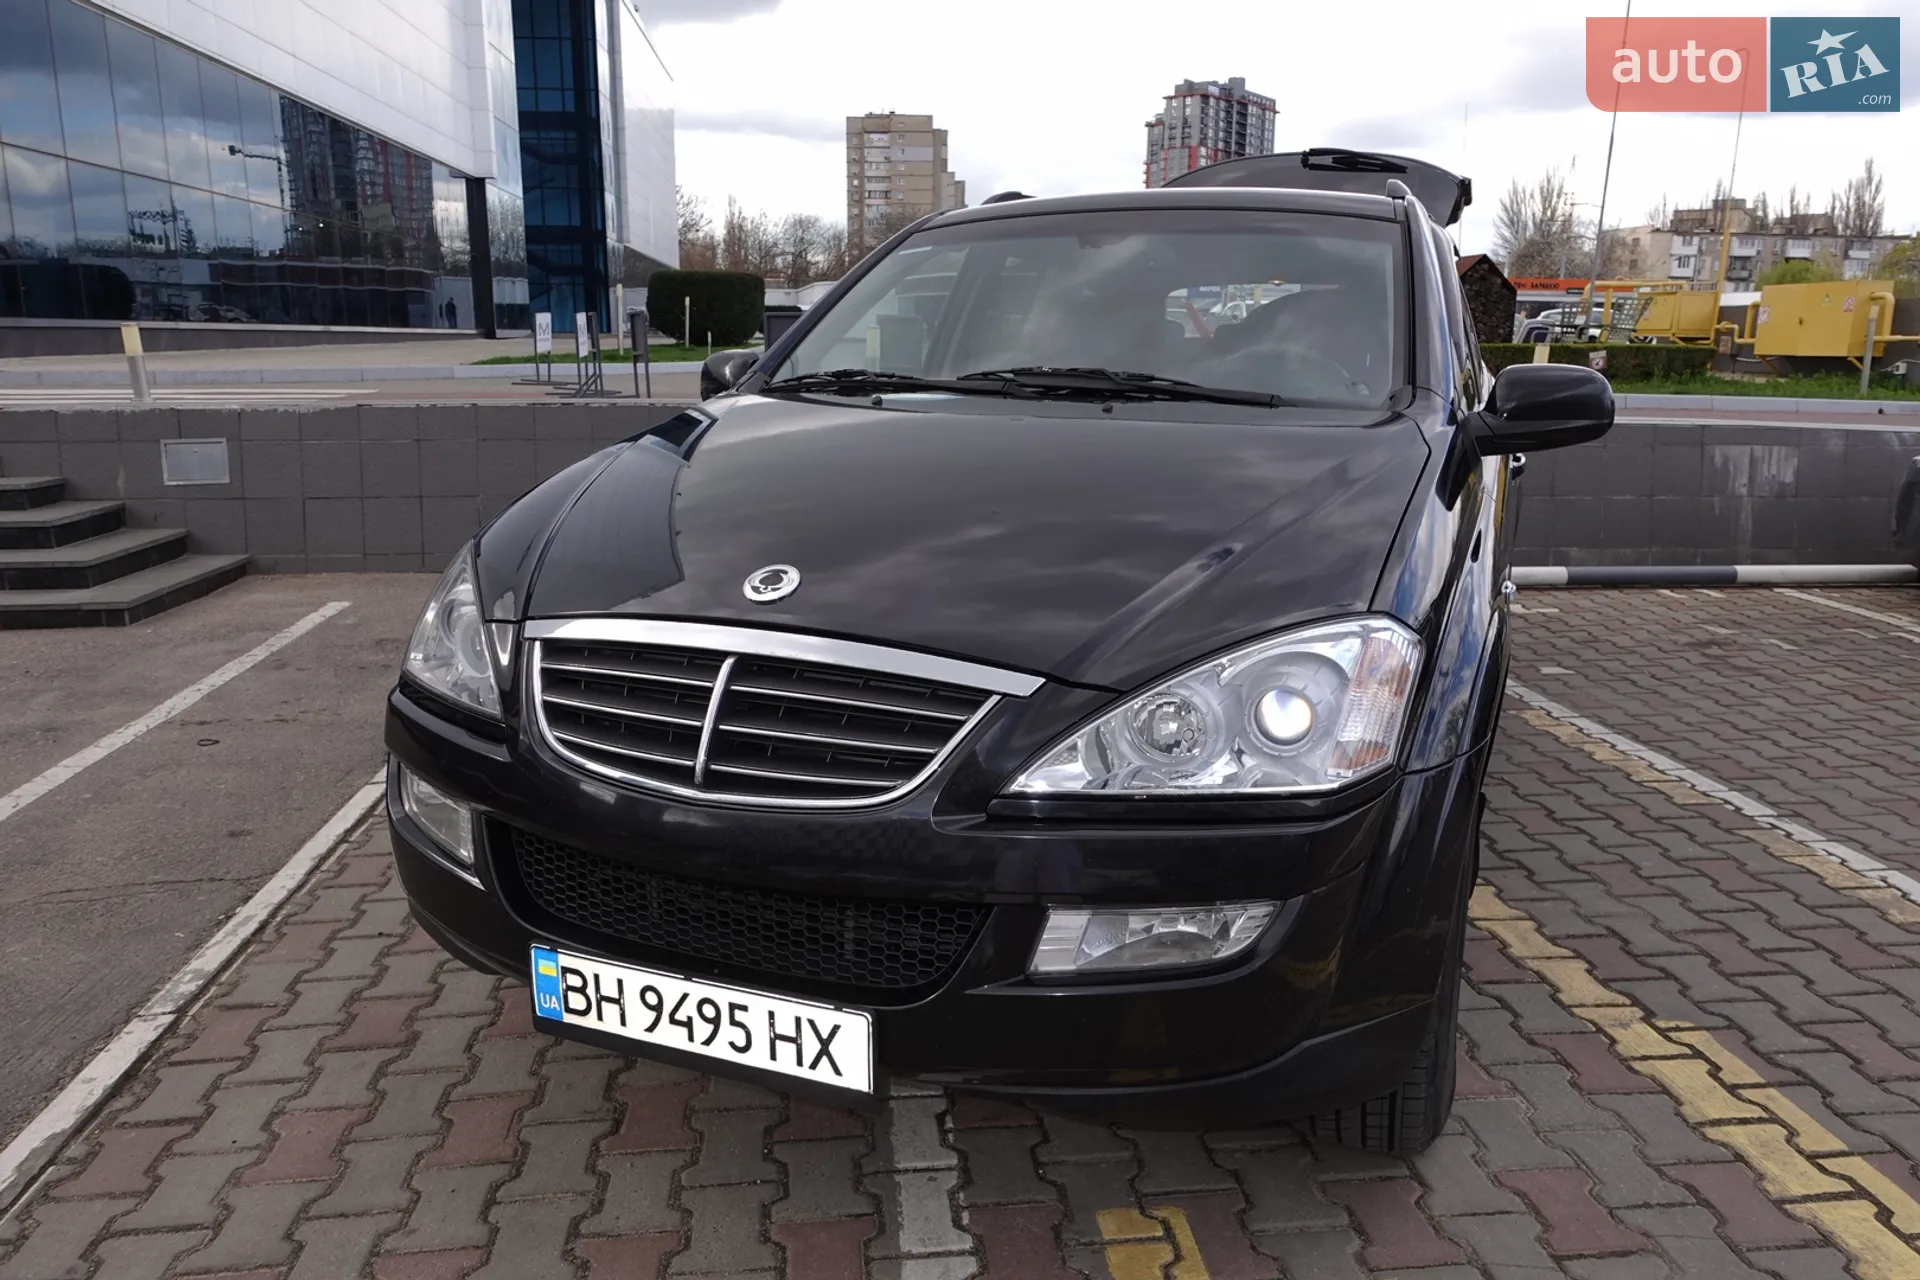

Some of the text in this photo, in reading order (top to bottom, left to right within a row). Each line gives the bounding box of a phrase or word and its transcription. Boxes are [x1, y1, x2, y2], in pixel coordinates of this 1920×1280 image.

[541, 992, 560, 1011] UA
[560, 966, 843, 1077] BH 9495 HX
